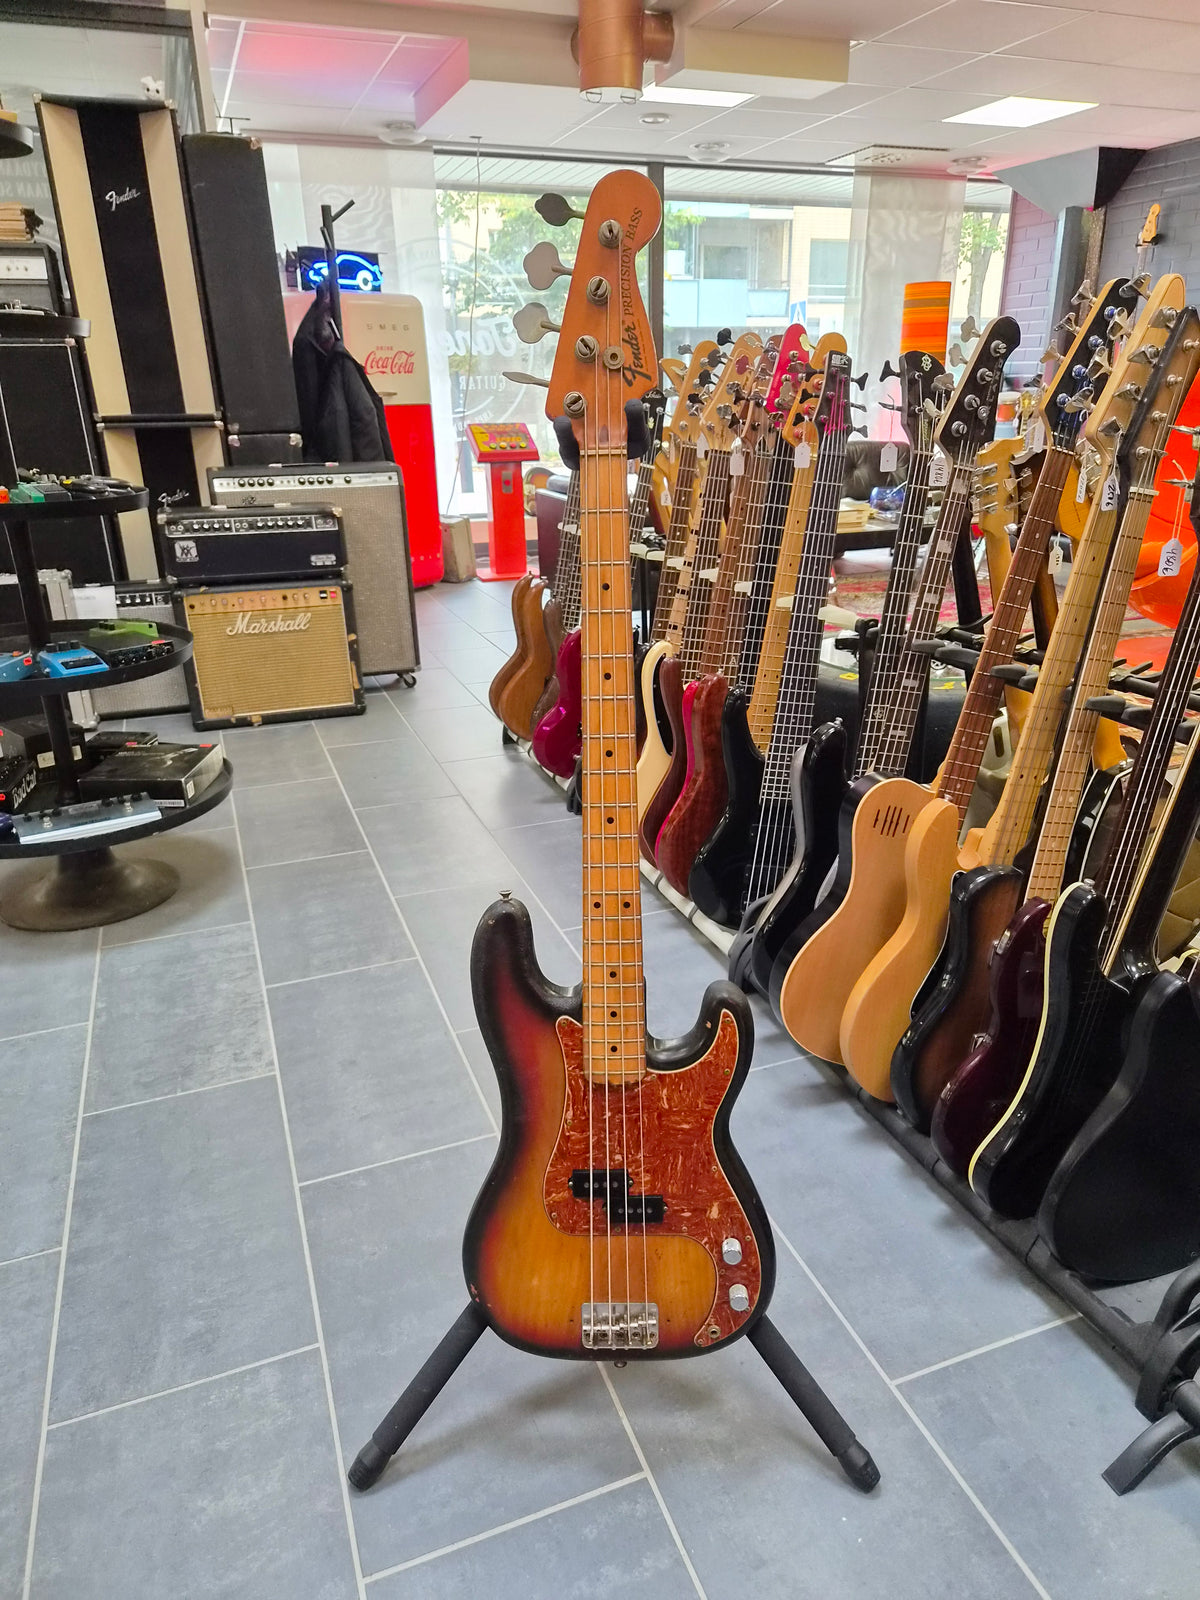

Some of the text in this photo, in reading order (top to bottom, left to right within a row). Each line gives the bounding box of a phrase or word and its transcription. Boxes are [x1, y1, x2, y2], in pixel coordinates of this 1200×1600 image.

[105, 187, 141, 211] Fender
[625, 207, 643, 243] BASS
[621, 245, 634, 318] PRECISION
[366, 323, 410, 332] SMEG
[364, 350, 416, 376] Coca-Cola
[622, 321, 652, 387] Fender
[226, 611, 312, 636] Marshall
